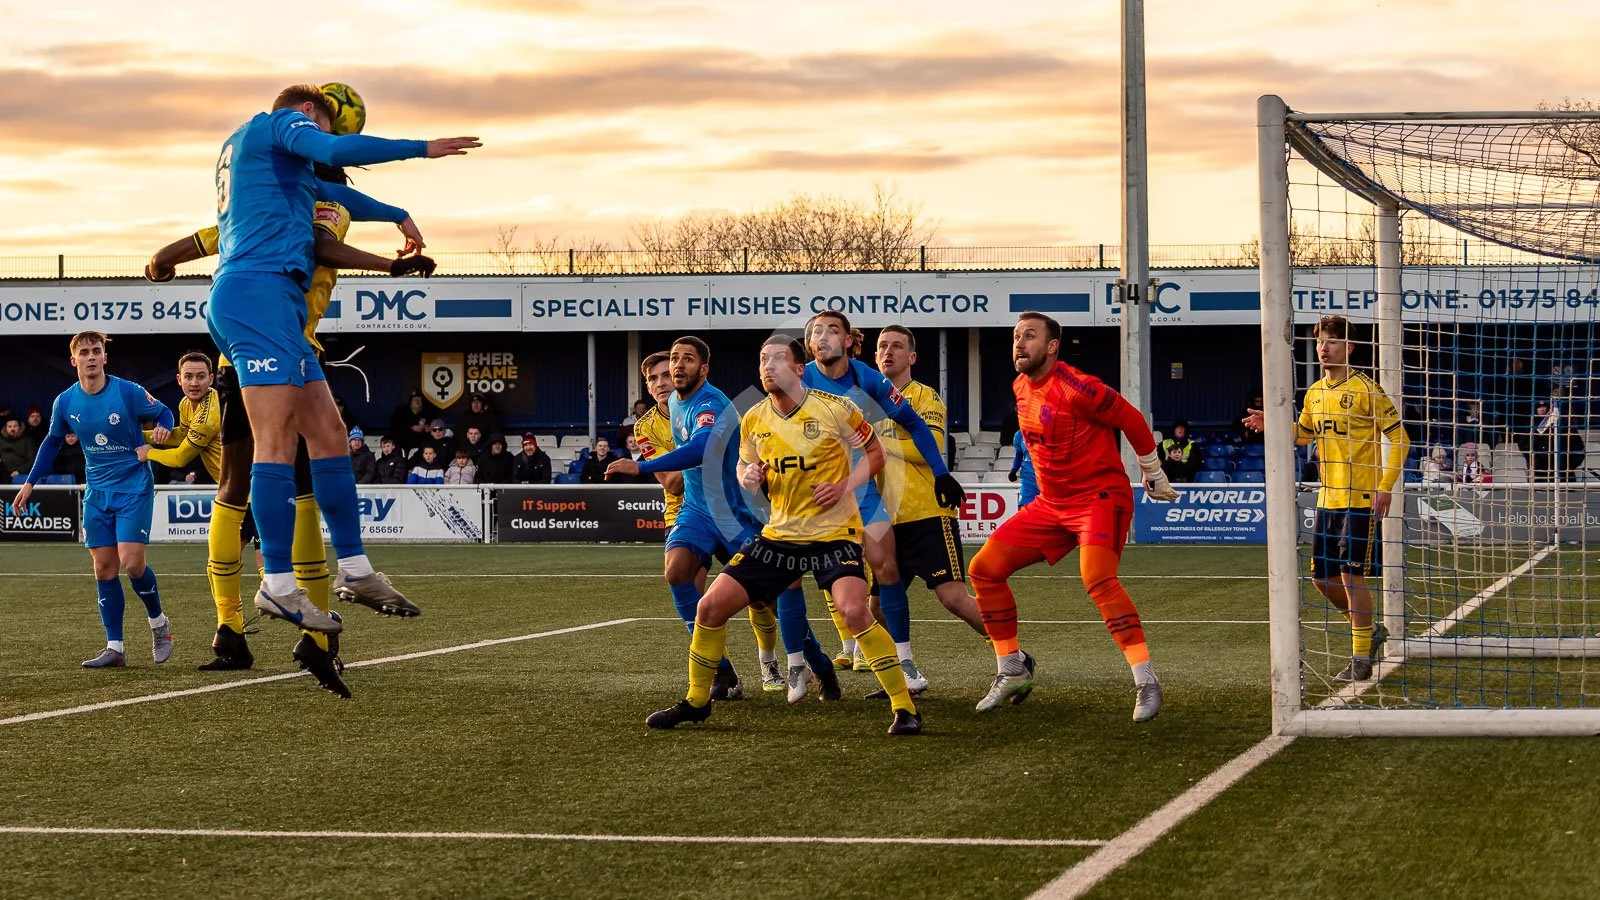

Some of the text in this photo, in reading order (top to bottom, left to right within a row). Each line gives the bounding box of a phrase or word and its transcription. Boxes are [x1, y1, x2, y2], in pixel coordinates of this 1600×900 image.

[1127, 284, 1139, 305] 4
[1293, 289, 1468, 310] TELEPONE:
[1478, 288, 1556, 309] 01375
[0, 302, 65, 321] ONE:
[73, 301, 144, 321] 01375
[356, 290, 427, 321] DMC
[532, 294, 989, 318] SPECIALIST FINISHES CONTRACTOR
[247, 357, 278, 373] DMC
[467, 352, 514, 366] #HER
[467, 366, 518, 379] GAME
[467, 379, 505, 393] TOO
[1189, 490, 1265, 504] WORLD
[523, 500, 587, 513] IT Support
[618, 500, 666, 513] Security
[1165, 508, 1252, 522] SPORTS
[1498, 511, 1547, 526] Helpng
[5, 517, 72, 529] FACADES
[511, 518, 599, 529] Cloud Services
